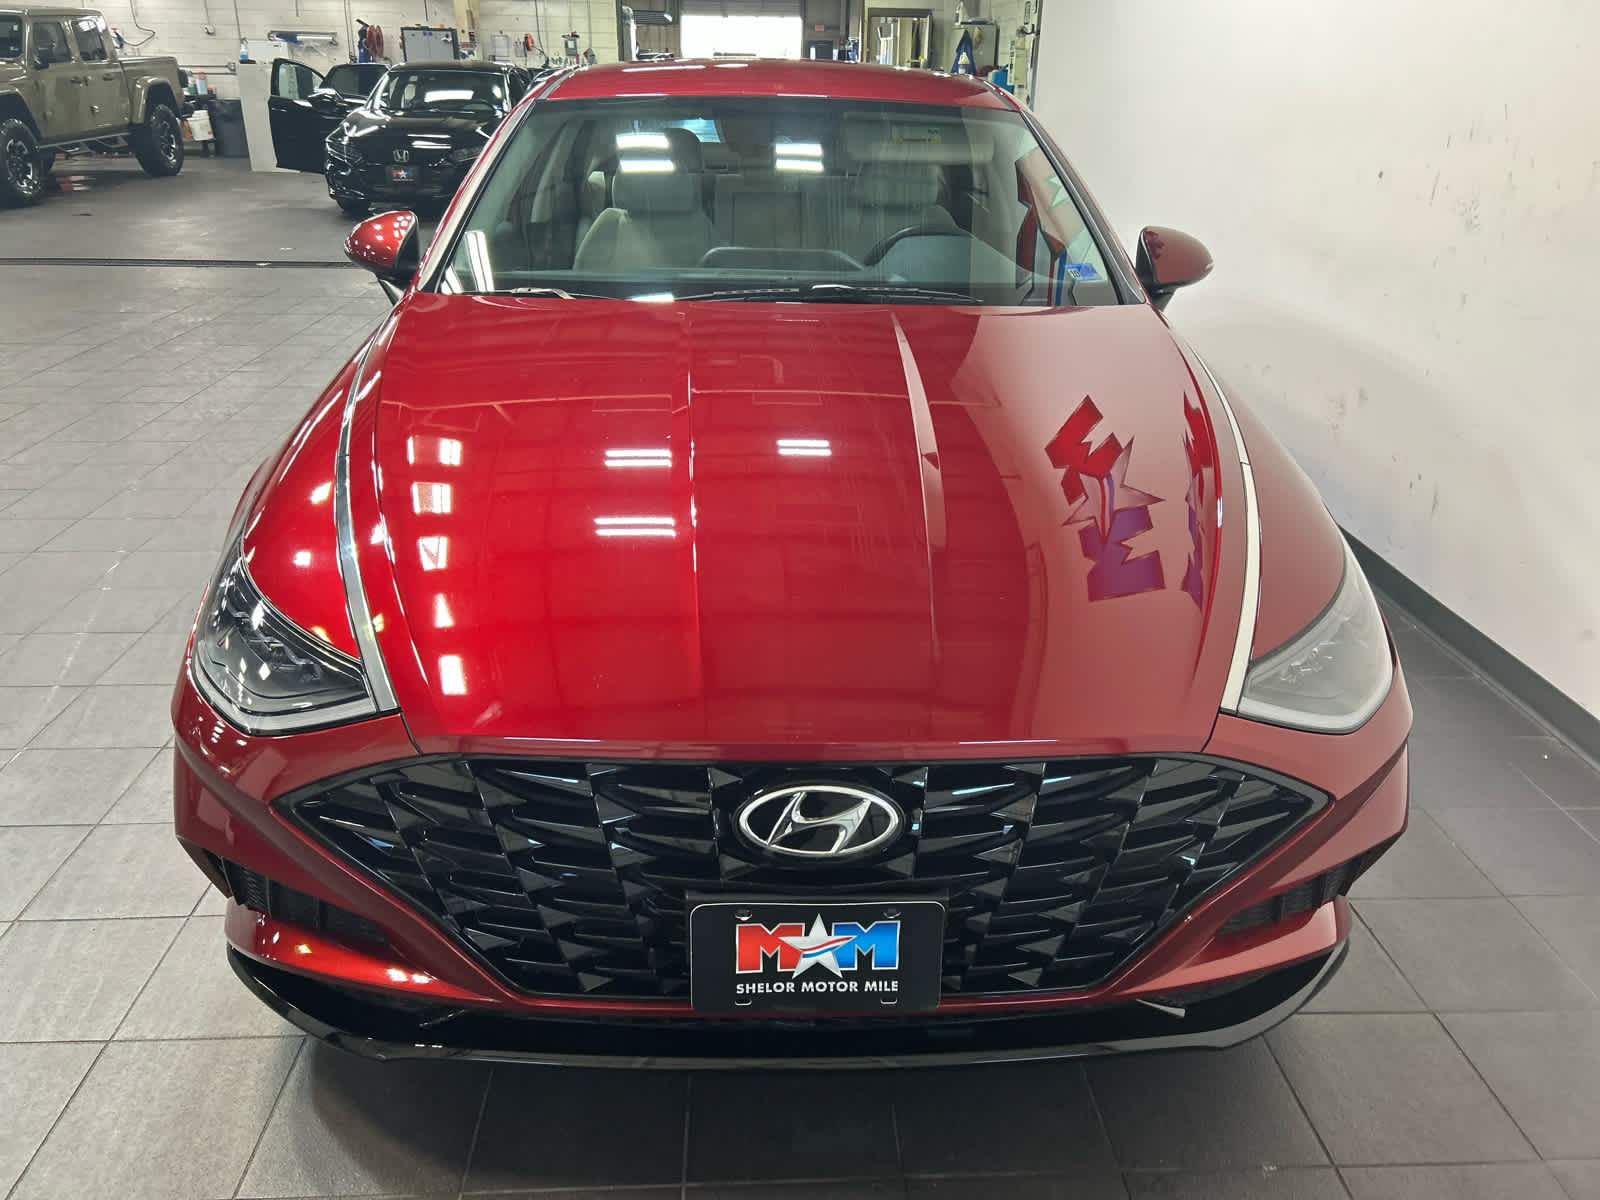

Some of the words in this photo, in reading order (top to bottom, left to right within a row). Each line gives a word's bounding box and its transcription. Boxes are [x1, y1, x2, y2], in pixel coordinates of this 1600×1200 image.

[736, 982, 795, 994] SHELOR
[801, 981, 858, 993] MOTOR
[864, 981, 899, 992] MILE
